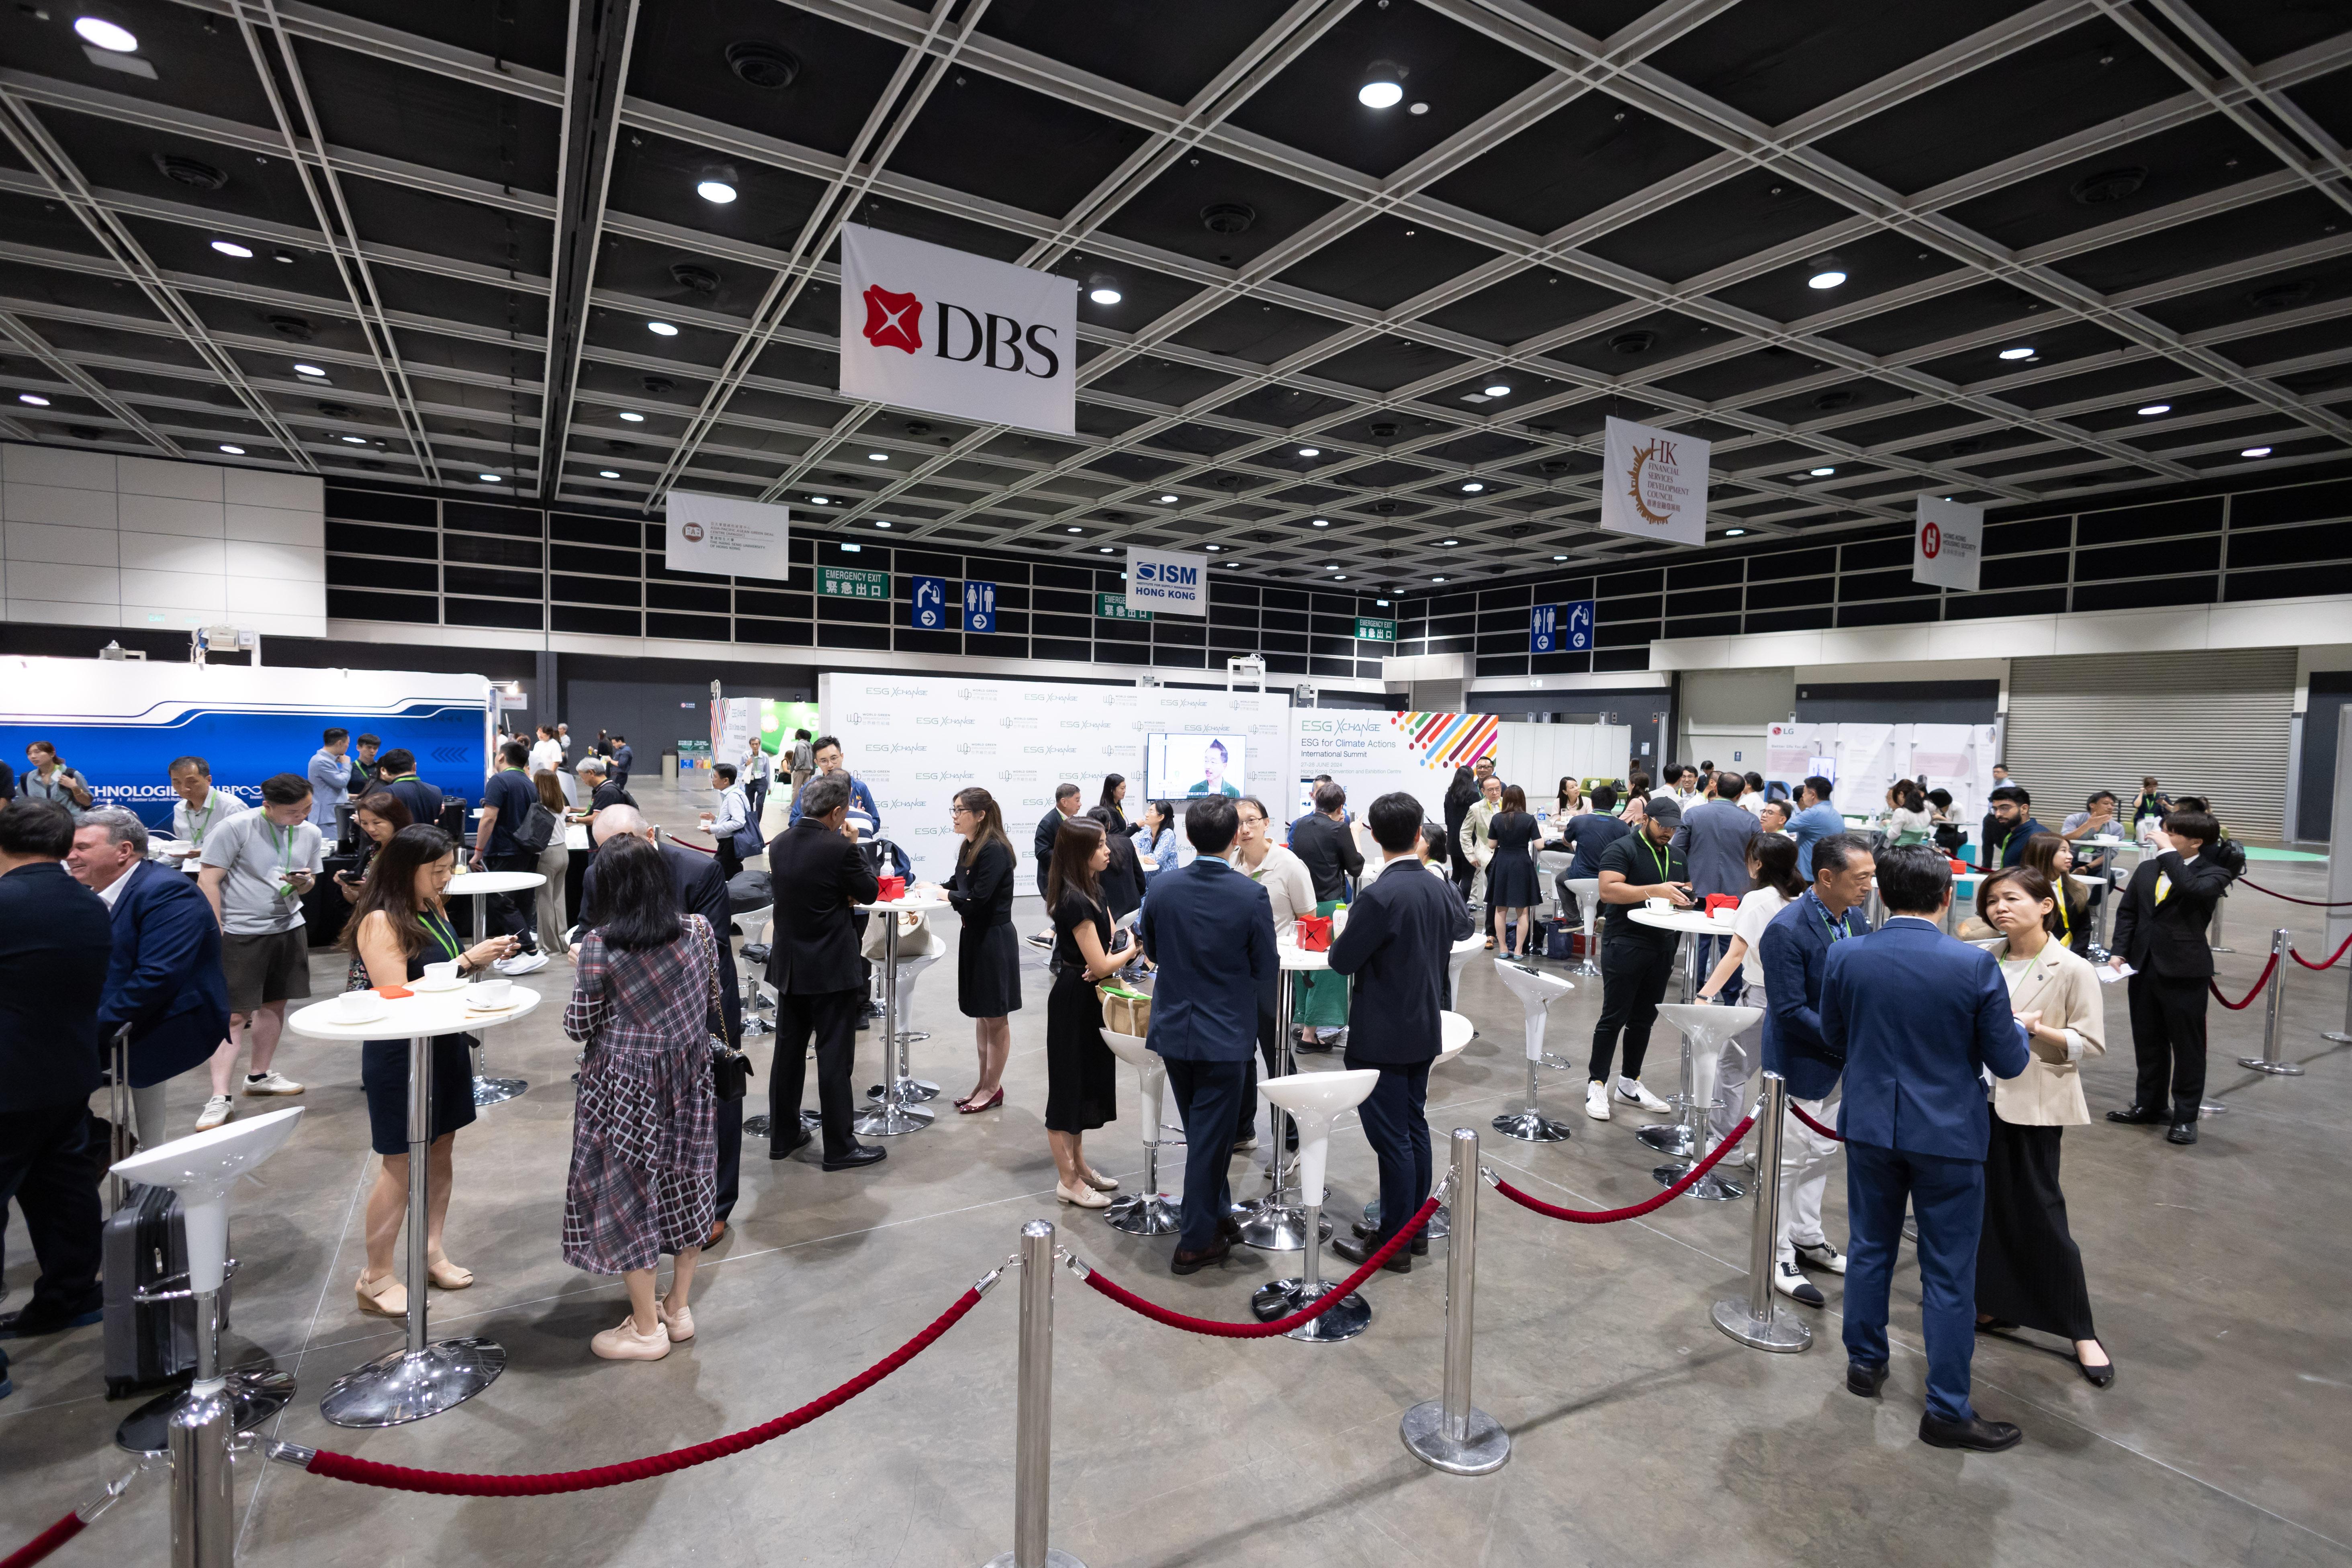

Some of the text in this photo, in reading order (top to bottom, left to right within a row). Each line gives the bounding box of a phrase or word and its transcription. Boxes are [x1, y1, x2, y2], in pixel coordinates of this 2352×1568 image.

[935, 301, 1059, 378] DBS
[1649, 437, 1677, 466] HK
[1648, 463, 1679, 476] FINANCIAL
[1648, 472, 1673, 483] SERVICES
[1648, 481, 1689, 495] DEVELOPMENT
[1647, 491, 1673, 501] COUNCIL
[826, 570, 881, 583] EMERGENCY EXIT
[1160, 564, 1196, 585] ISM
[826, 580, 881, 597] 緊急出口
[1136, 587, 1195, 600] HONG KONG
[1105, 595, 1126, 604] EMERGE
[1360, 619, 1383, 628] EMERGENCY
[1360, 628, 1392, 639] 緊急出口
[1302, 720, 1332, 731] ESG
[1302, 738, 1396, 748] ESG for Climate Actions
[88, 786, 180, 797] HNOLOGIE
